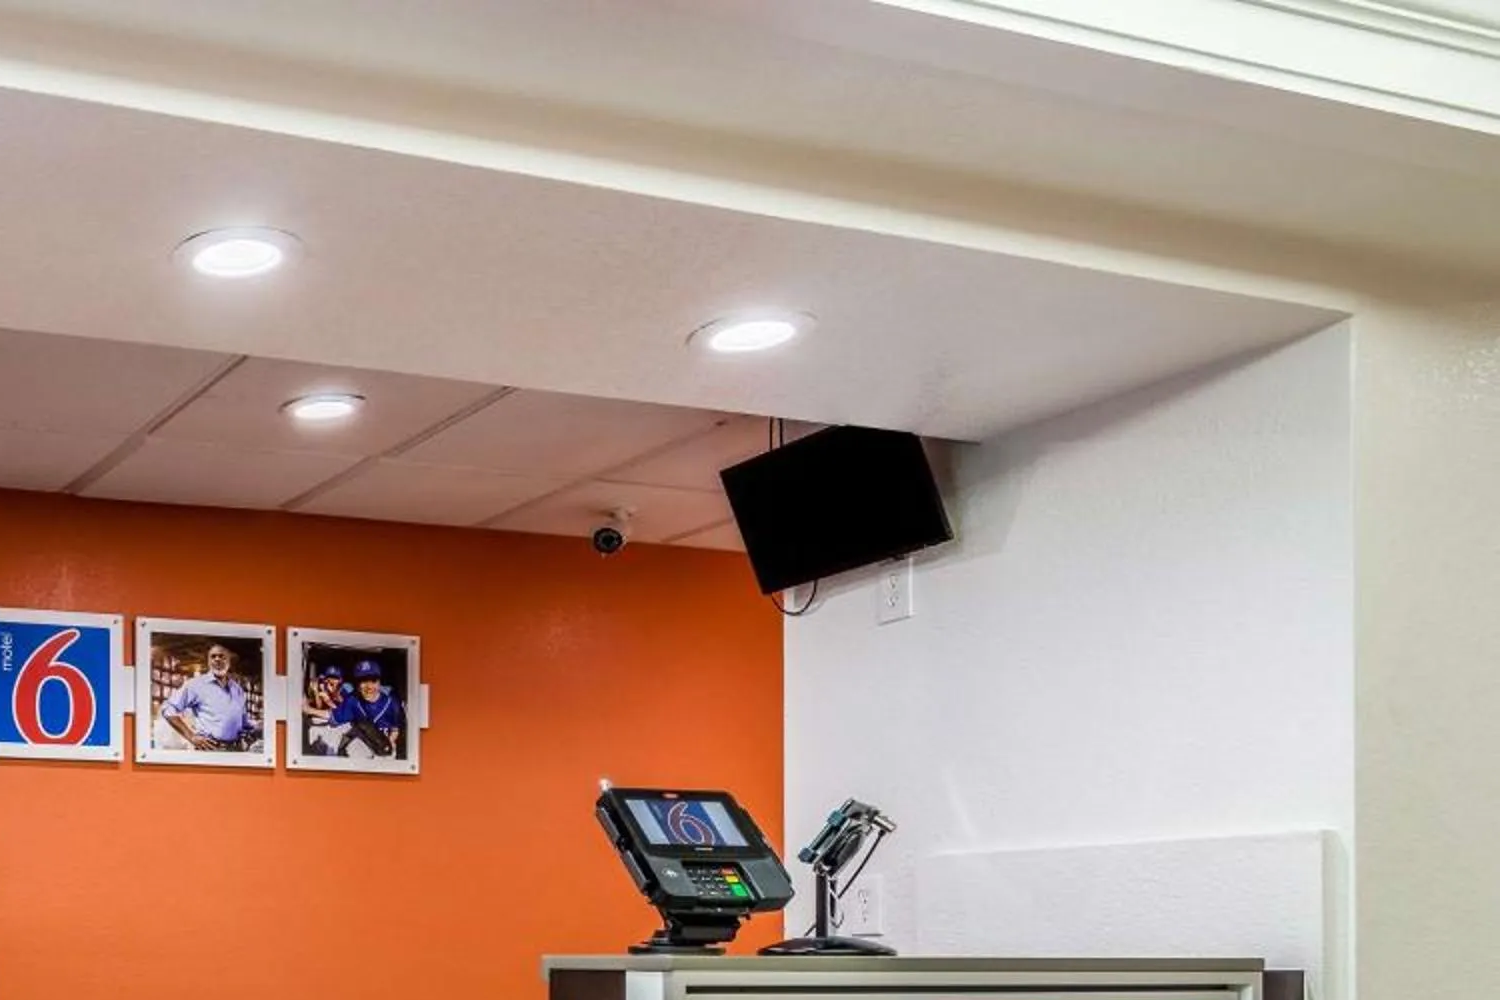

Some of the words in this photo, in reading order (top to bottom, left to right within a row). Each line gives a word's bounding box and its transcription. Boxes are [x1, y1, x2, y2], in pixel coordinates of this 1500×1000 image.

[0, 631, 13, 672] motel
[12, 628, 97, 746] 6
[667, 801, 716, 845] 6
